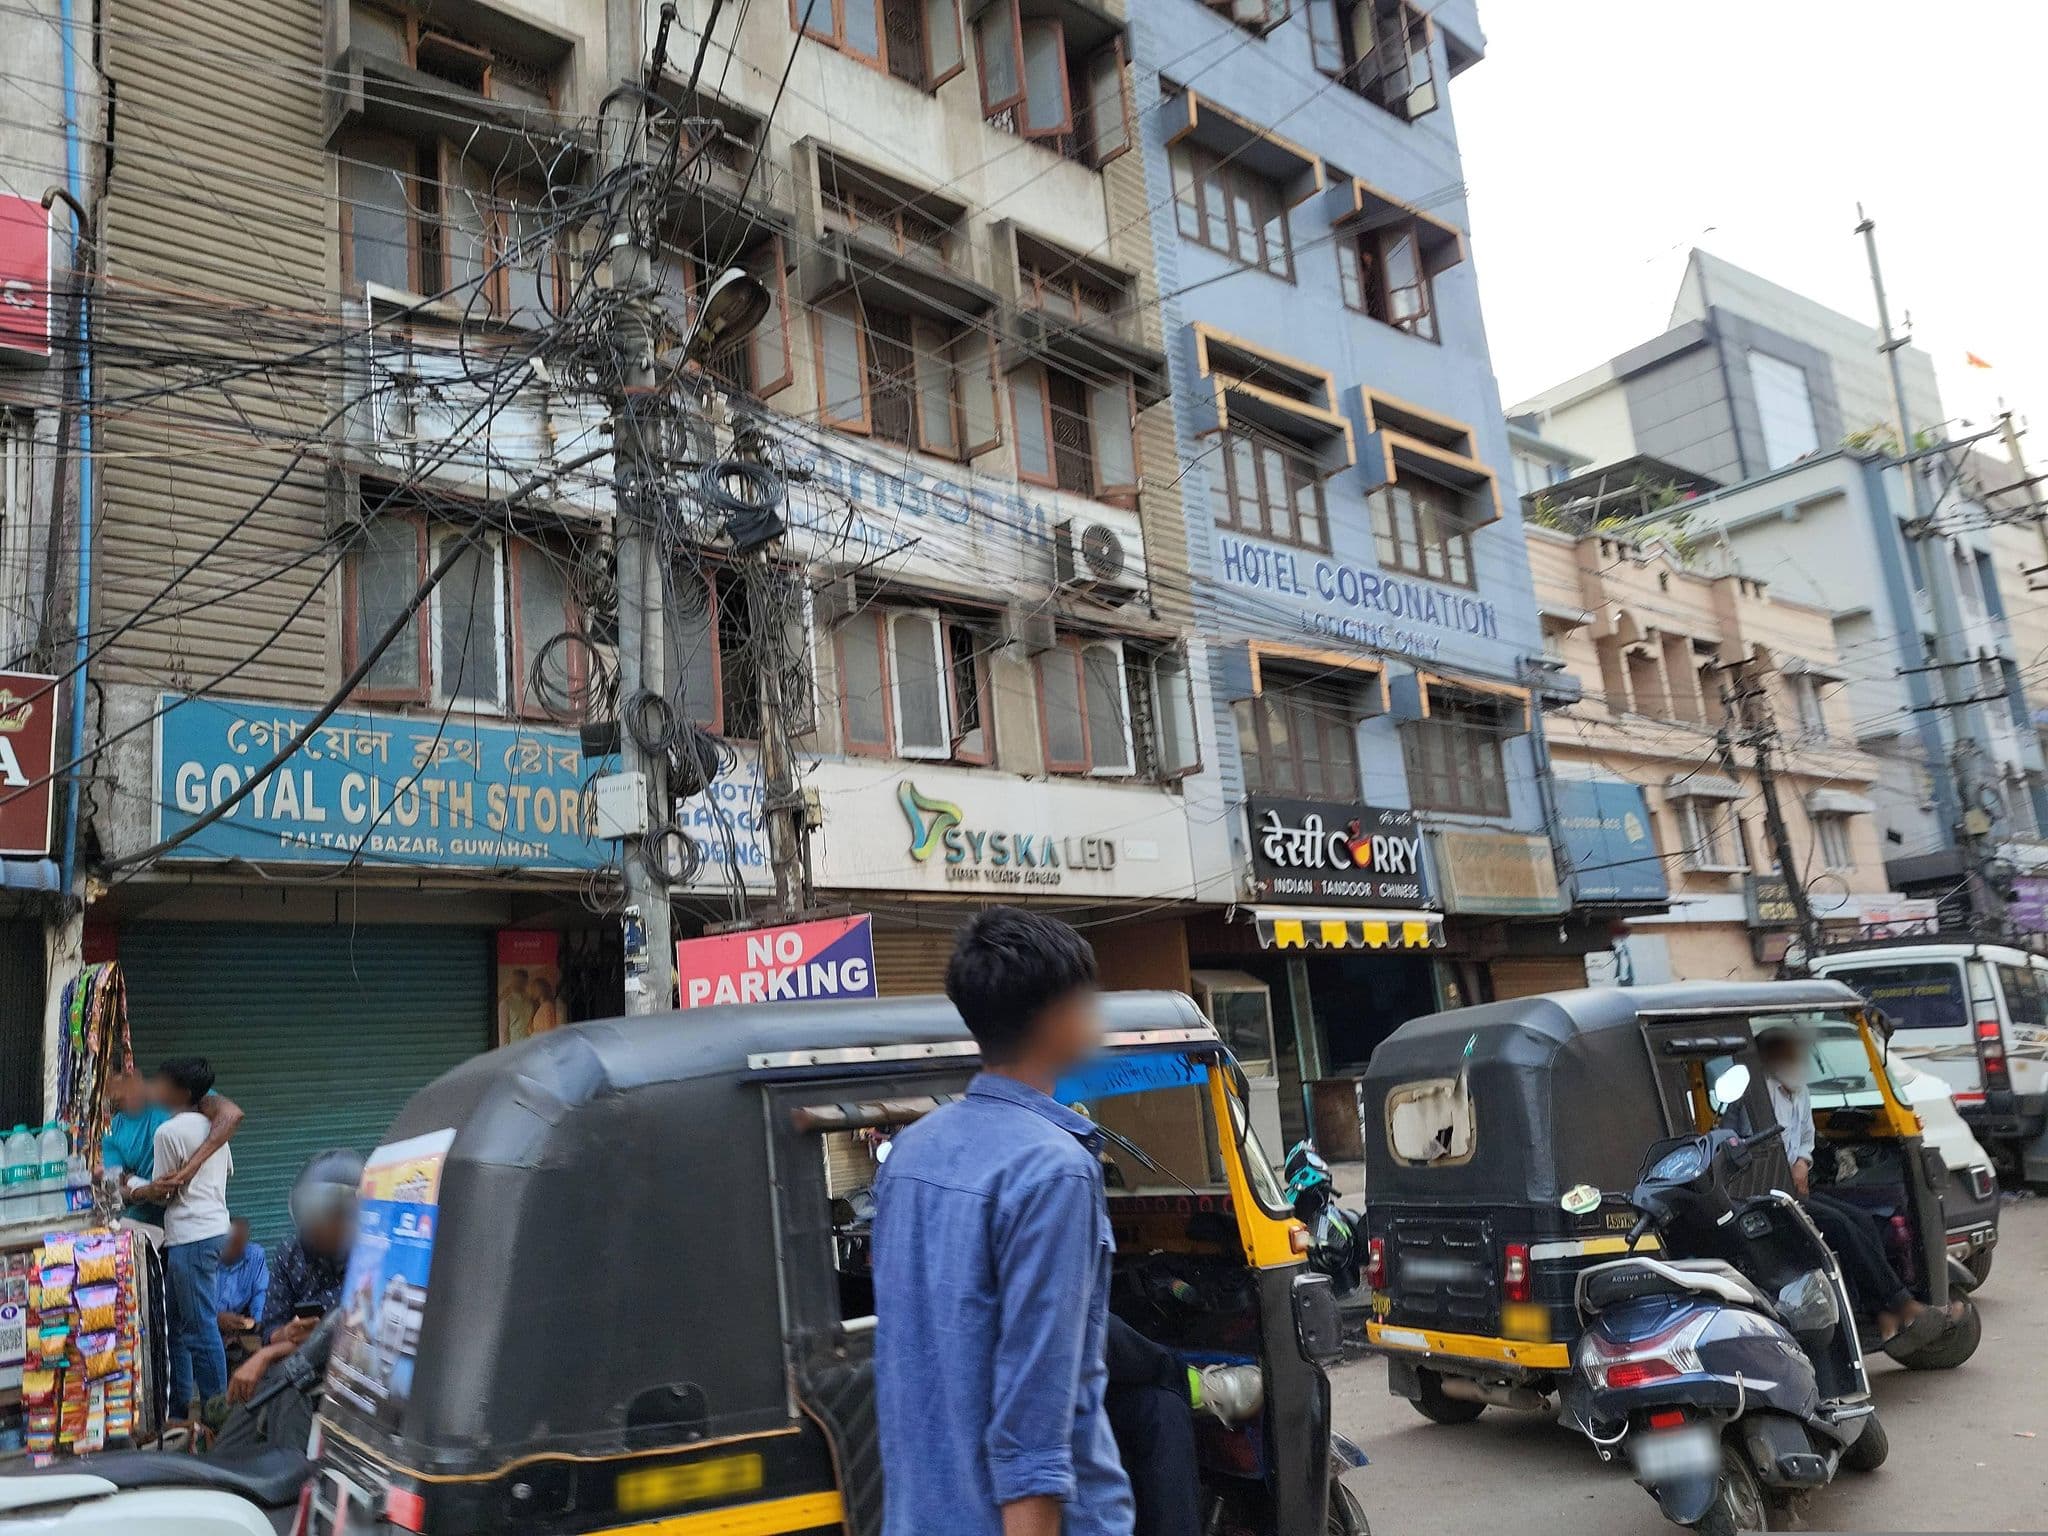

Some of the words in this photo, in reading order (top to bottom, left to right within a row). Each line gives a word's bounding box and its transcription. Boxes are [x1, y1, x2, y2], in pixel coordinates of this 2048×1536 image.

[1222, 538, 1307, 597] HOTEL
[1314, 558, 1499, 640] CORONATION
[175, 761, 327, 822] GOYAL
[340, 771, 474, 829] CLOTH
[280, 831, 364, 851] PALTAN
[371, 834, 444, 857] BAZAR,
[944, 829, 1060, 868] SYSKA
[1064, 836, 1117, 871] LED
[1262, 809, 1326, 869] देसी
[1273, 877, 1313, 895] INDIAN
[1378, 882, 1420, 899] CHINESE
[746, 930, 804, 969] NO
[688, 957, 869, 1009] PARKING
